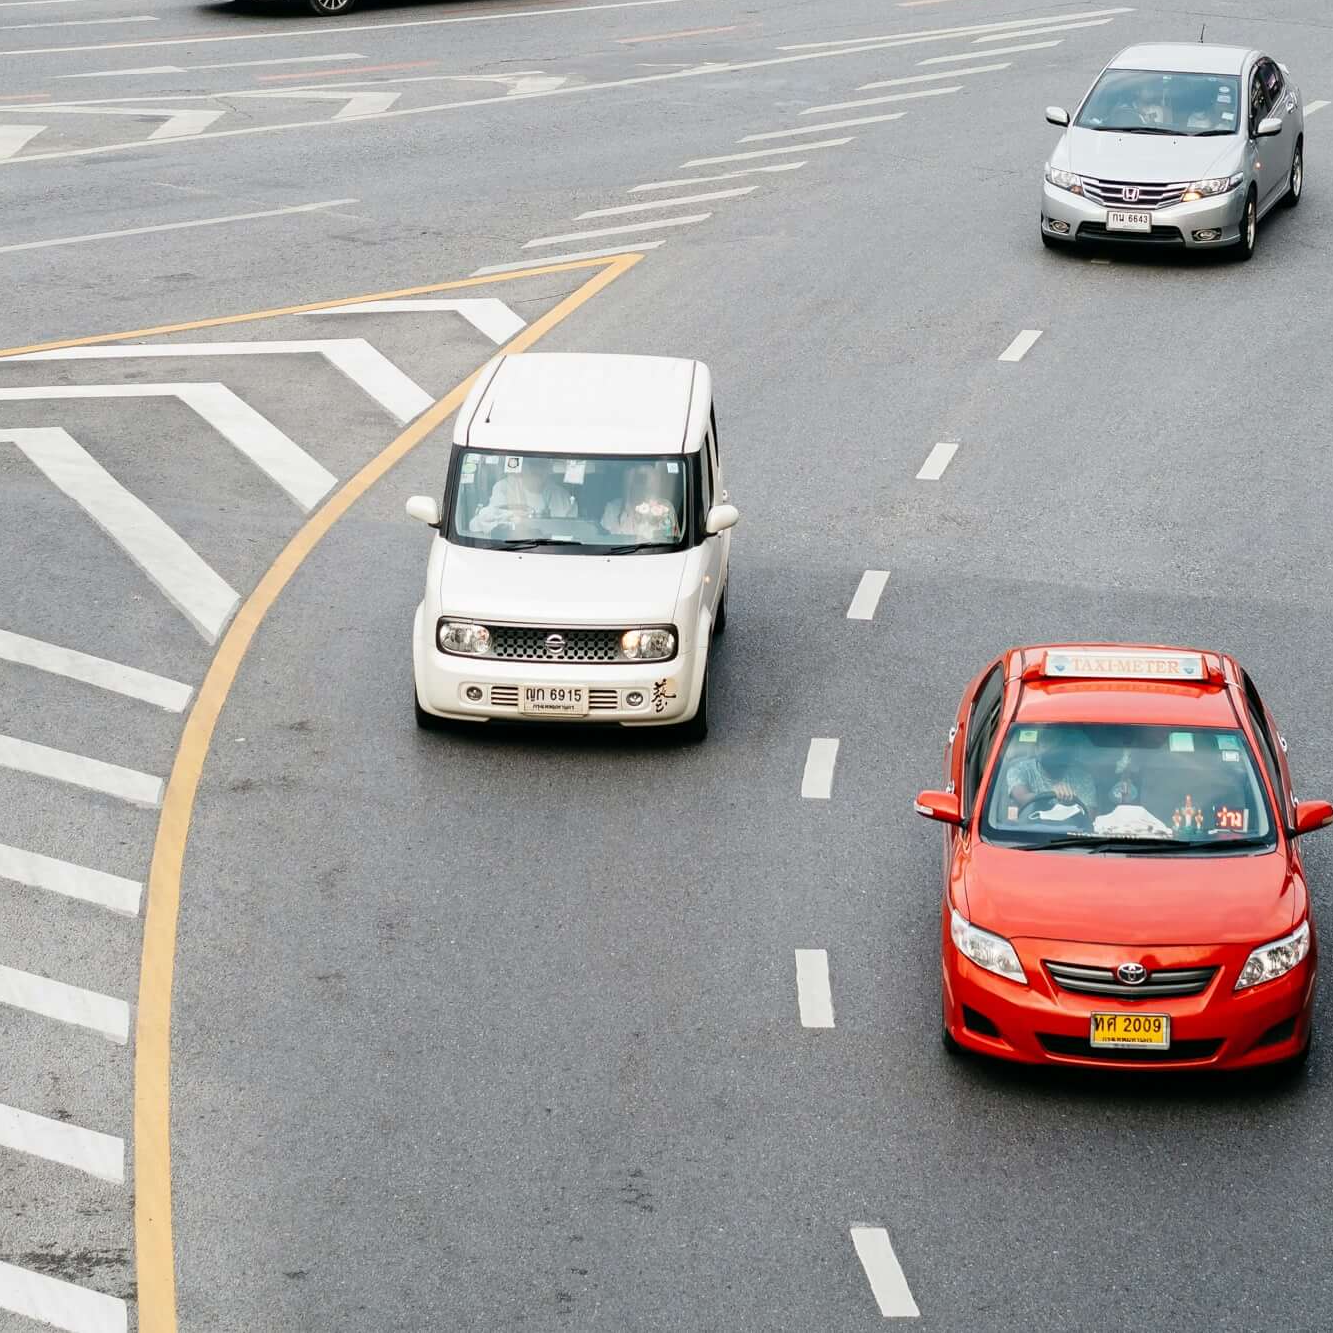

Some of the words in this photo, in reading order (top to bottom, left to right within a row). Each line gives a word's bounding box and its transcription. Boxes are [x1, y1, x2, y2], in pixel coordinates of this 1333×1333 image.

[1128, 214, 1148, 224] 6643
[549, 688, 582, 702] 6915
[1124, 1017, 1162, 1033] 2009
